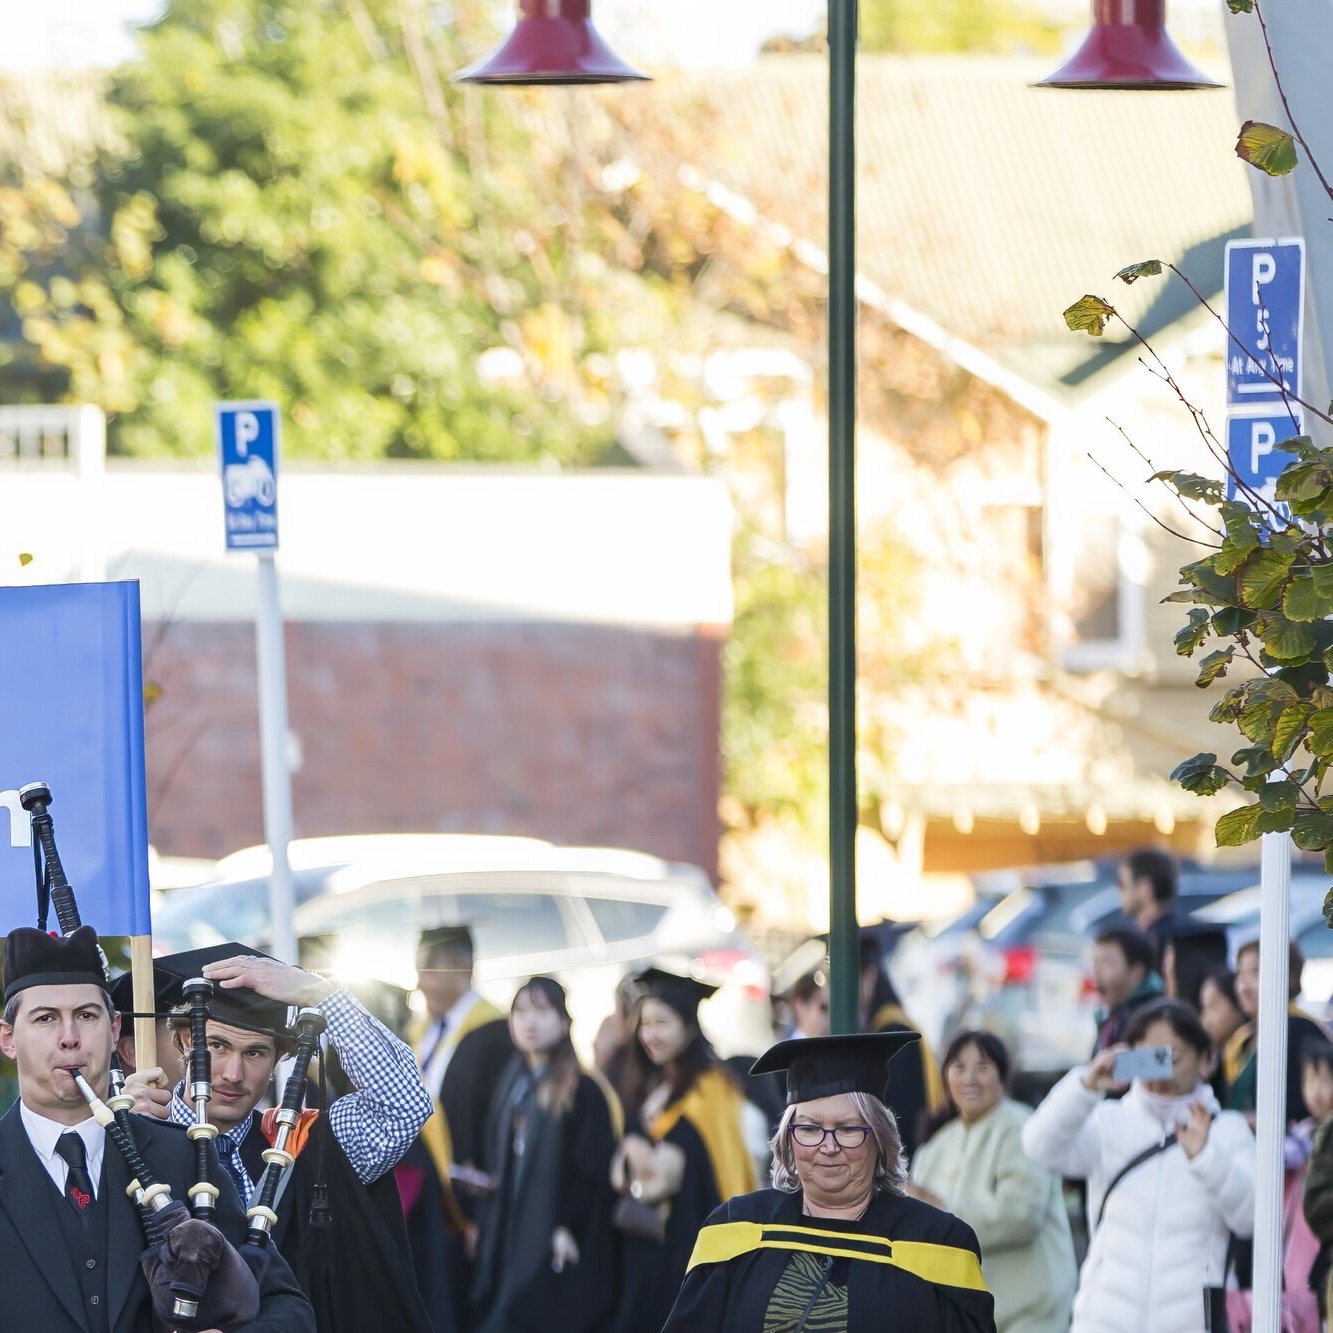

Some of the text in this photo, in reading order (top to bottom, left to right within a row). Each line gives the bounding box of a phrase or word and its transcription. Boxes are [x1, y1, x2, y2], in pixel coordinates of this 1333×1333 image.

[1252, 252, 1277, 306] P
[1256, 308, 1271, 350] 5
[235, 411, 260, 458] P
[1251, 421, 1276, 474] P
